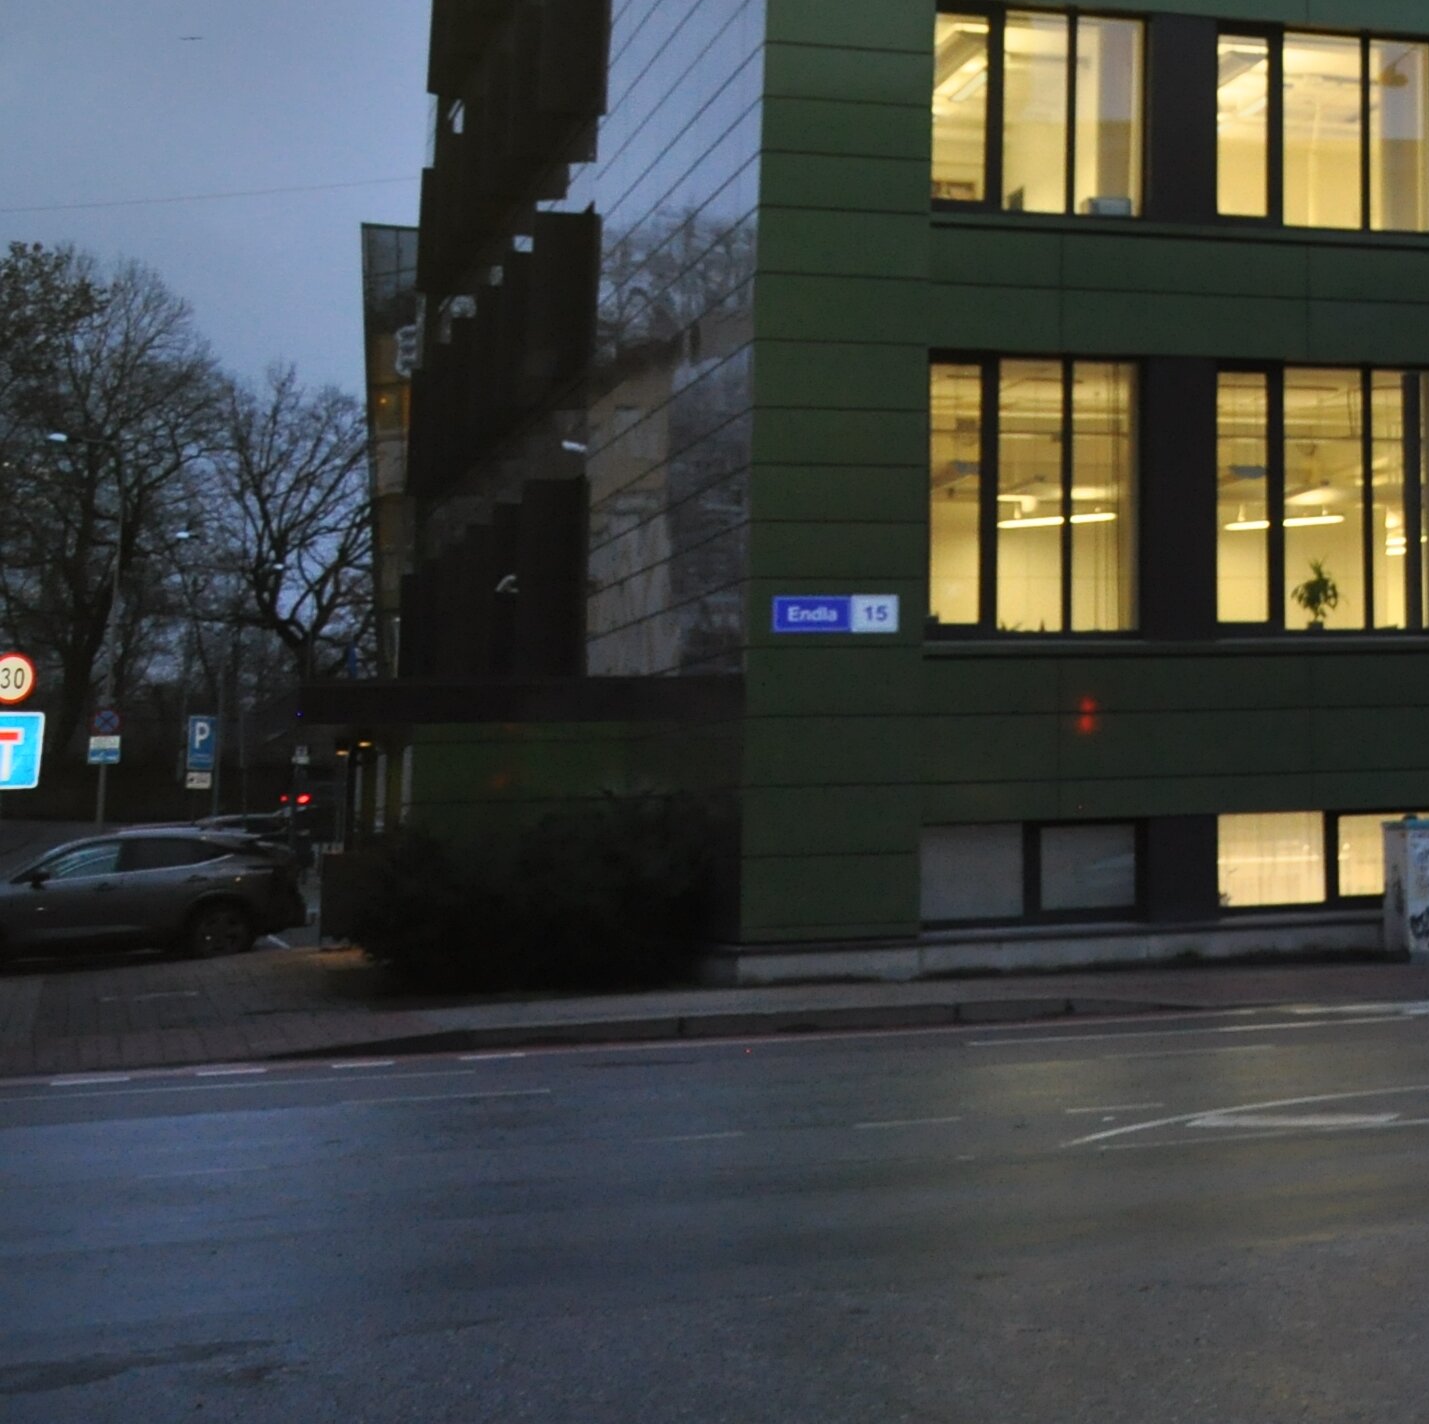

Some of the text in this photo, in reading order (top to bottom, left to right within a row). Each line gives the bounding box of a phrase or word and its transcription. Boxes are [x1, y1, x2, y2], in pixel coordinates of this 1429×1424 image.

[787, 606, 888, 623] Endla 15
[1, 667, 25, 689] 30
